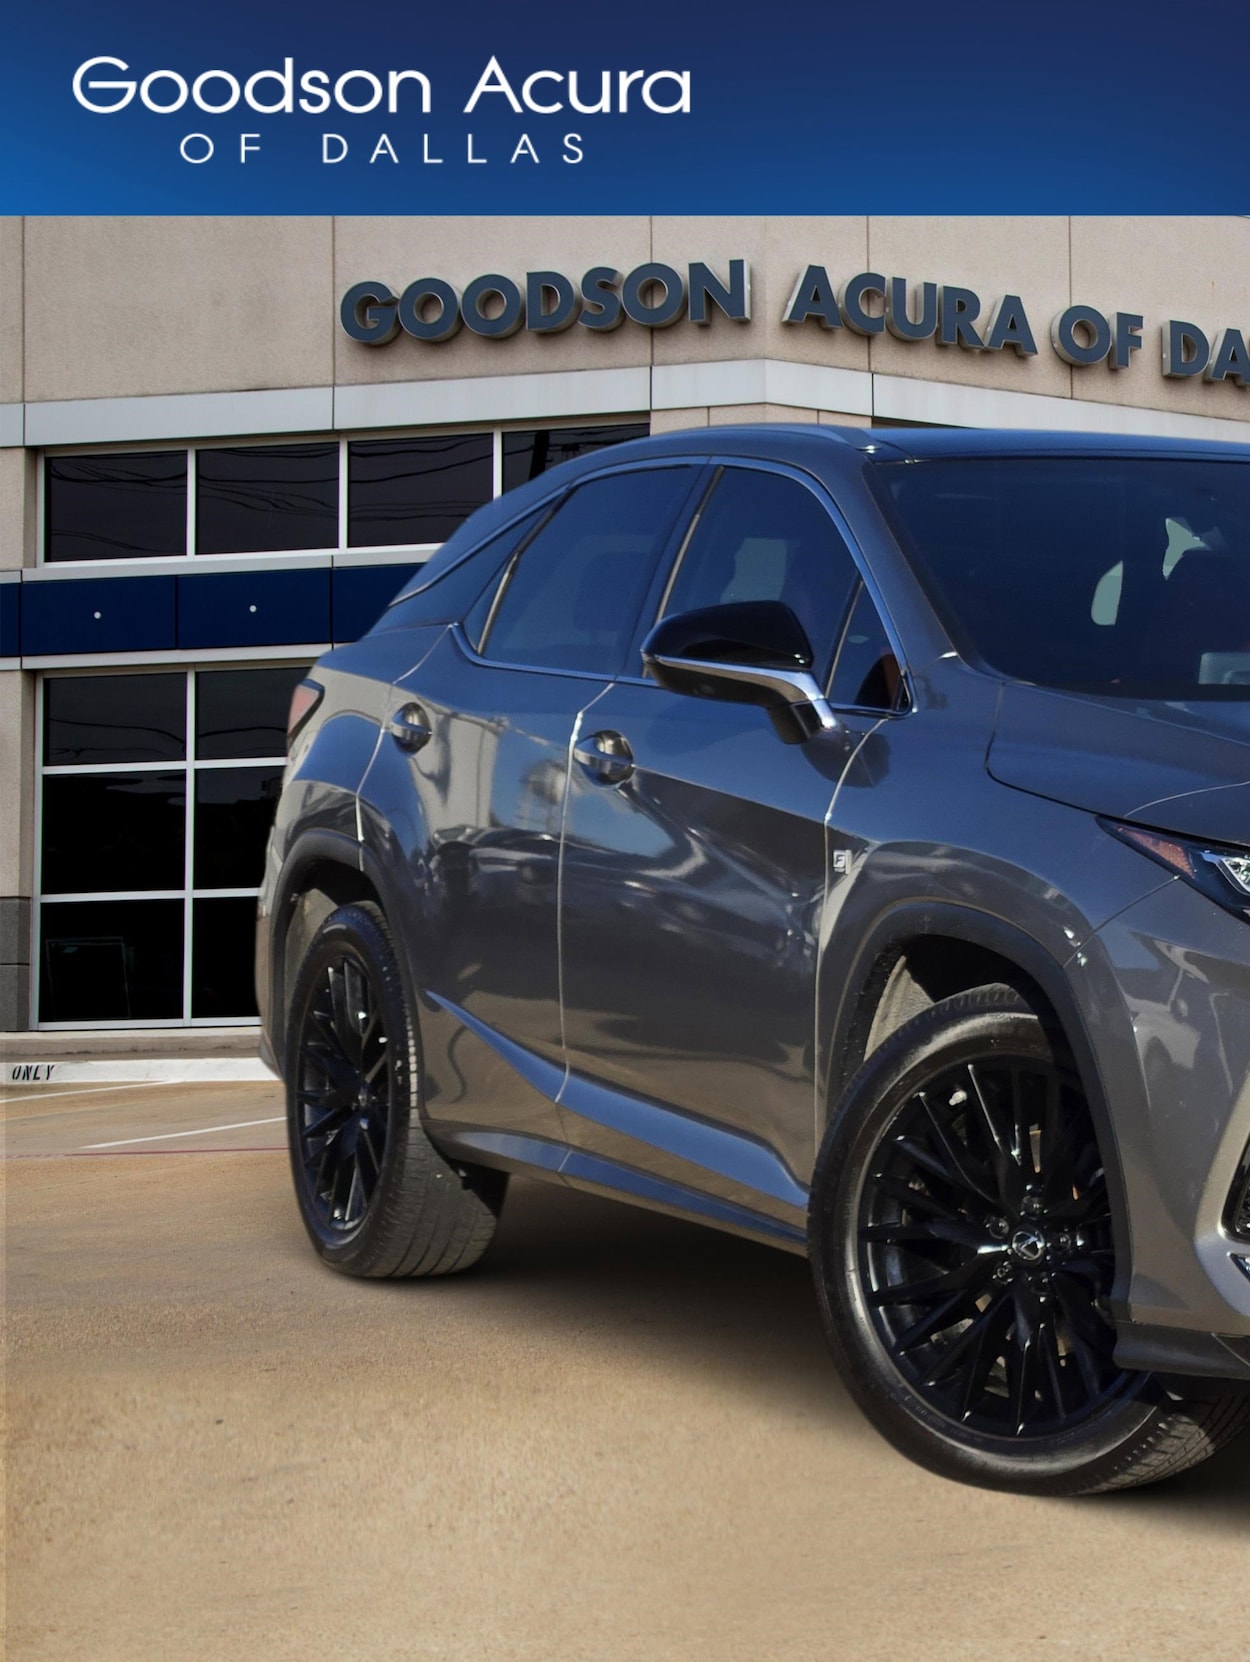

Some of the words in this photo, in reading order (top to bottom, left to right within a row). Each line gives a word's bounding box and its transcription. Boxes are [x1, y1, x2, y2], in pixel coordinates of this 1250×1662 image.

[339, 257, 751, 346] GOODSON
[781, 263, 1038, 357] ACURA
[1050, 304, 1144, 370] OF
[11, 1064, 56, 1081] ONLY
